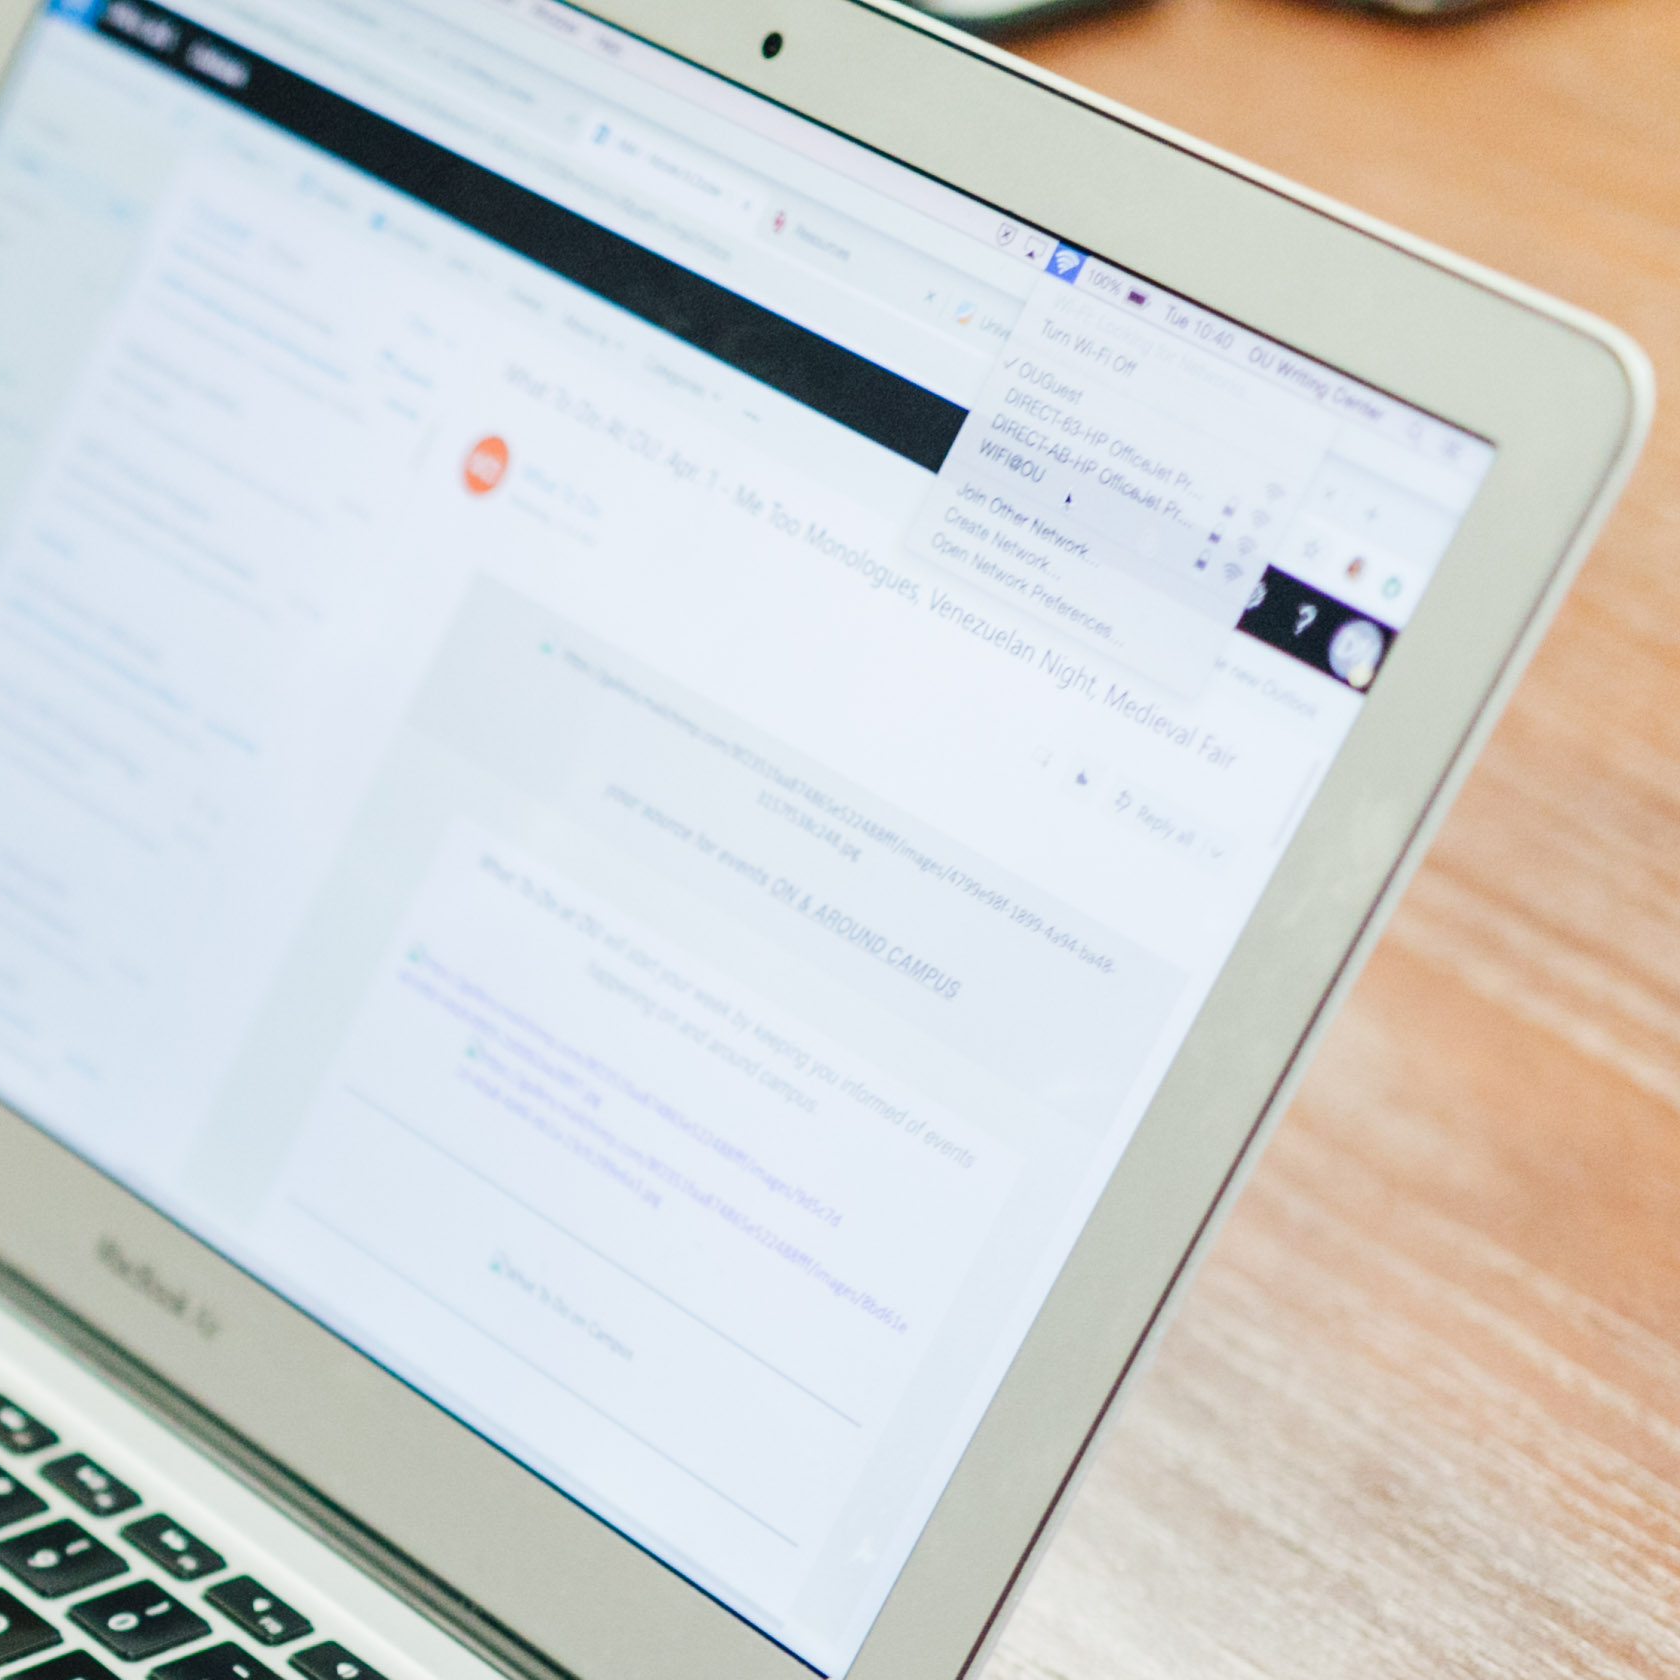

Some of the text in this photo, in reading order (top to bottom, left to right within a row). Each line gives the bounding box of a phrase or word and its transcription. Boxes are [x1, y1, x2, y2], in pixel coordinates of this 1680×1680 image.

[1018, 360, 1084, 404] OUGuest
[1041, 318, 1139, 378] Turn Wi-Fi Off
[1087, 267, 1385, 421] 100% Tue 10:40 OU Writing Center
[979, 437, 1048, 483] WIFI@OU
[991, 412, 1098, 474] DIRECT-AB-HP
[1098, 467, 1163, 513] OfficeJet
[1108, 438, 1174, 485] OfficeJet
[944, 505, 1061, 581] Create Network...
[956, 480, 1100, 569] Join Other Network...
[731, 484, 766, 517] Me
[767, 501, 802, 538] Too
[802, 521, 921, 606] Monologues,
[928, 587, 1037, 664] Venezuelan
[1038, 648, 1100, 701] Night,
[1101, 683, 1199, 749] Medieval
[1197, 731, 1240, 770] Fair
[930, 531, 1125, 648] Open Network Preferences...
[1135, 804, 1198, 848] Reply all
[695, 832, 718, 854] for
[718, 849, 770, 888] events
[770, 875, 798, 904] ON
[797, 894, 814, 914] &
[812, 903, 888, 955] AROUND
[885, 945, 964, 1001] CAMPUS
[656, 966, 693, 993] your
[693, 985, 731, 1018] week
[731, 1008, 753, 1033] by
[752, 1022, 811, 1070] keeping
[810, 1055, 839, 1086] you
[839, 1072, 907, 1123] informed
[905, 1110, 924, 1135] of
[922, 1124, 977, 1171] events
[678, 1013, 709, 1044] and
[707, 1036, 761, 1079] around
[107, 1612, 139, 1631] 0
